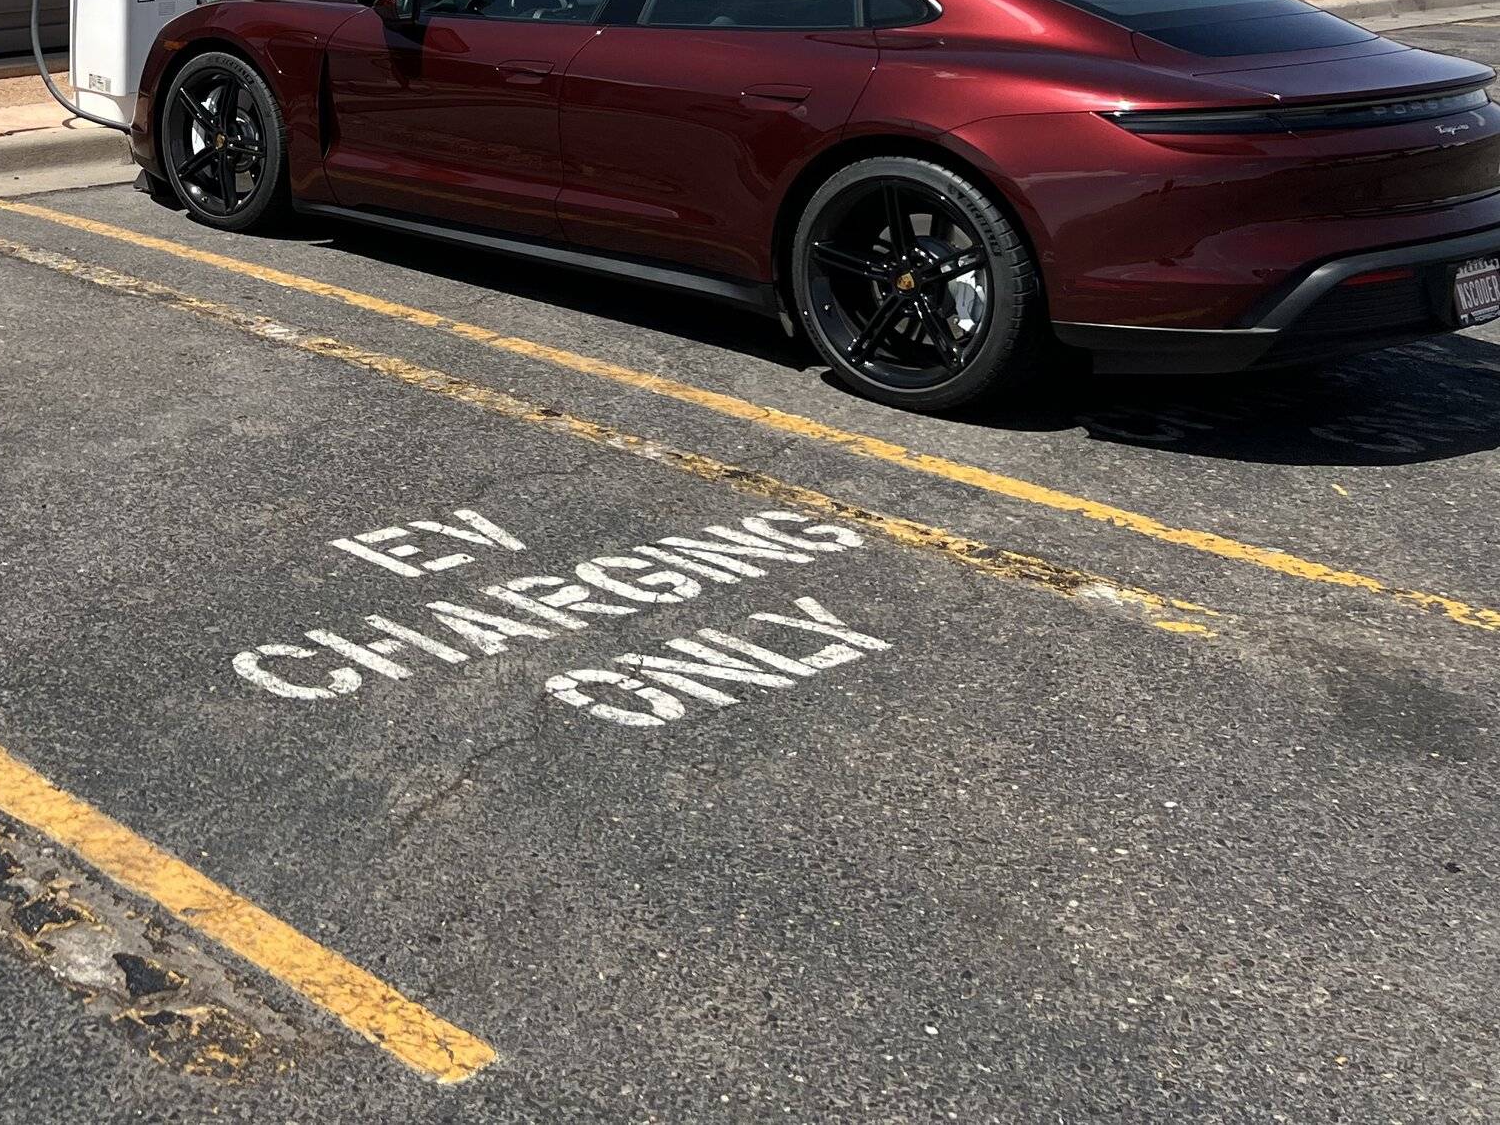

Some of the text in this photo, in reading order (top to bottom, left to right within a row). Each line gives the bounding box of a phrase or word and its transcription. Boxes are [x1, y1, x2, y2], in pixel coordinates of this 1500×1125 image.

[231, 511, 866, 700] CHARGING
[328, 509, 526, 576] EV
[544, 596, 894, 727] ONLY
